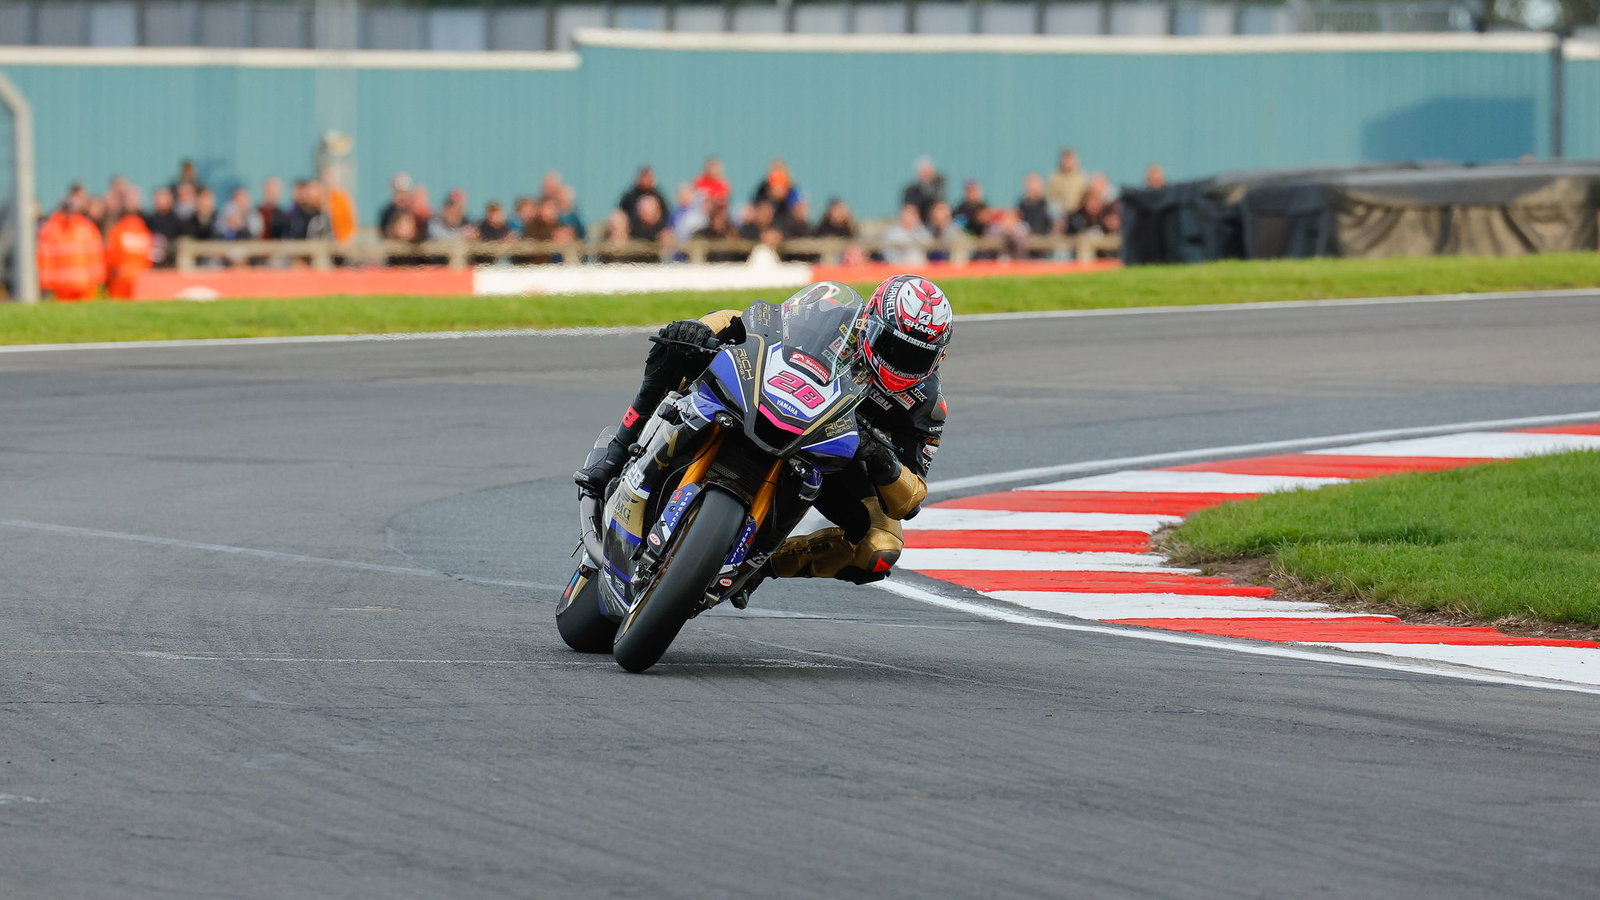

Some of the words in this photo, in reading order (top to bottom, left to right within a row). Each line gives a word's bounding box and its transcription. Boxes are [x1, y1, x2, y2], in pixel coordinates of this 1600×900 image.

[886, 281, 903, 320] BURNELL
[903, 318, 938, 336] SHARK
[738, 348, 754, 380] RICH
[805, 358, 828, 379] Bennetts
[767, 370, 826, 410] 28
[776, 399, 799, 416] YAMAHA
[825, 416, 853, 433] RICH
[670, 491, 692, 527] PIRELLI
[730, 526, 752, 563] PIRELLI
